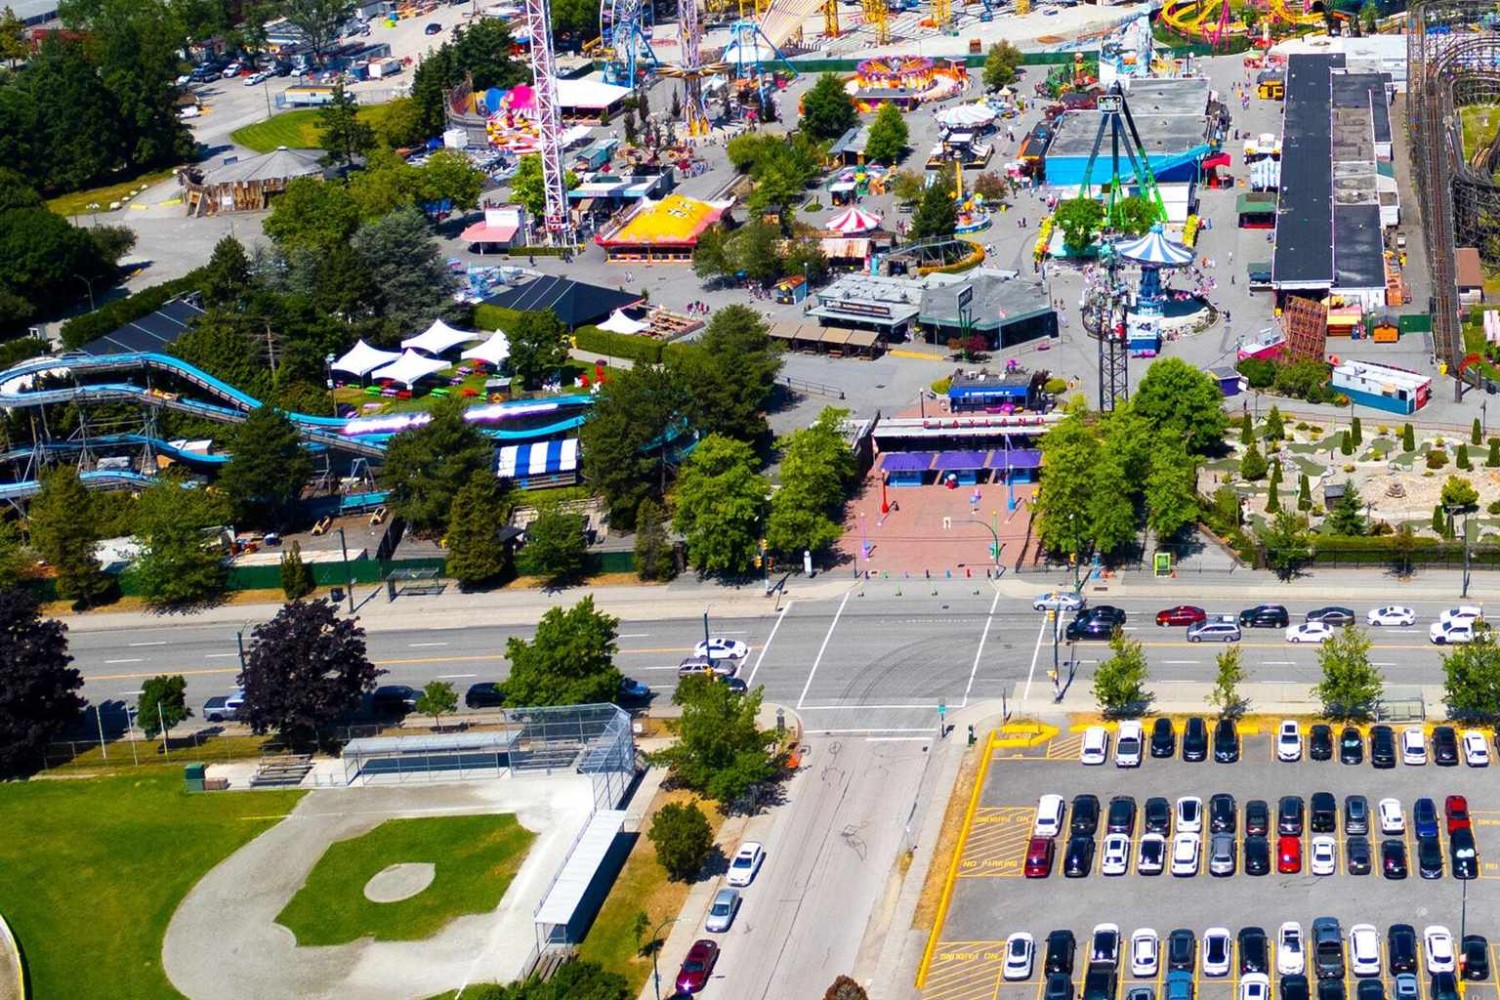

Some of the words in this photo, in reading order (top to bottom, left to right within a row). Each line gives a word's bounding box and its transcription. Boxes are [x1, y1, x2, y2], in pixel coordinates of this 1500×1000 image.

[923, 417, 1046, 429] PLAYLAND
[963, 860, 977, 868] NO
[982, 860, 1018, 868] PARKING
